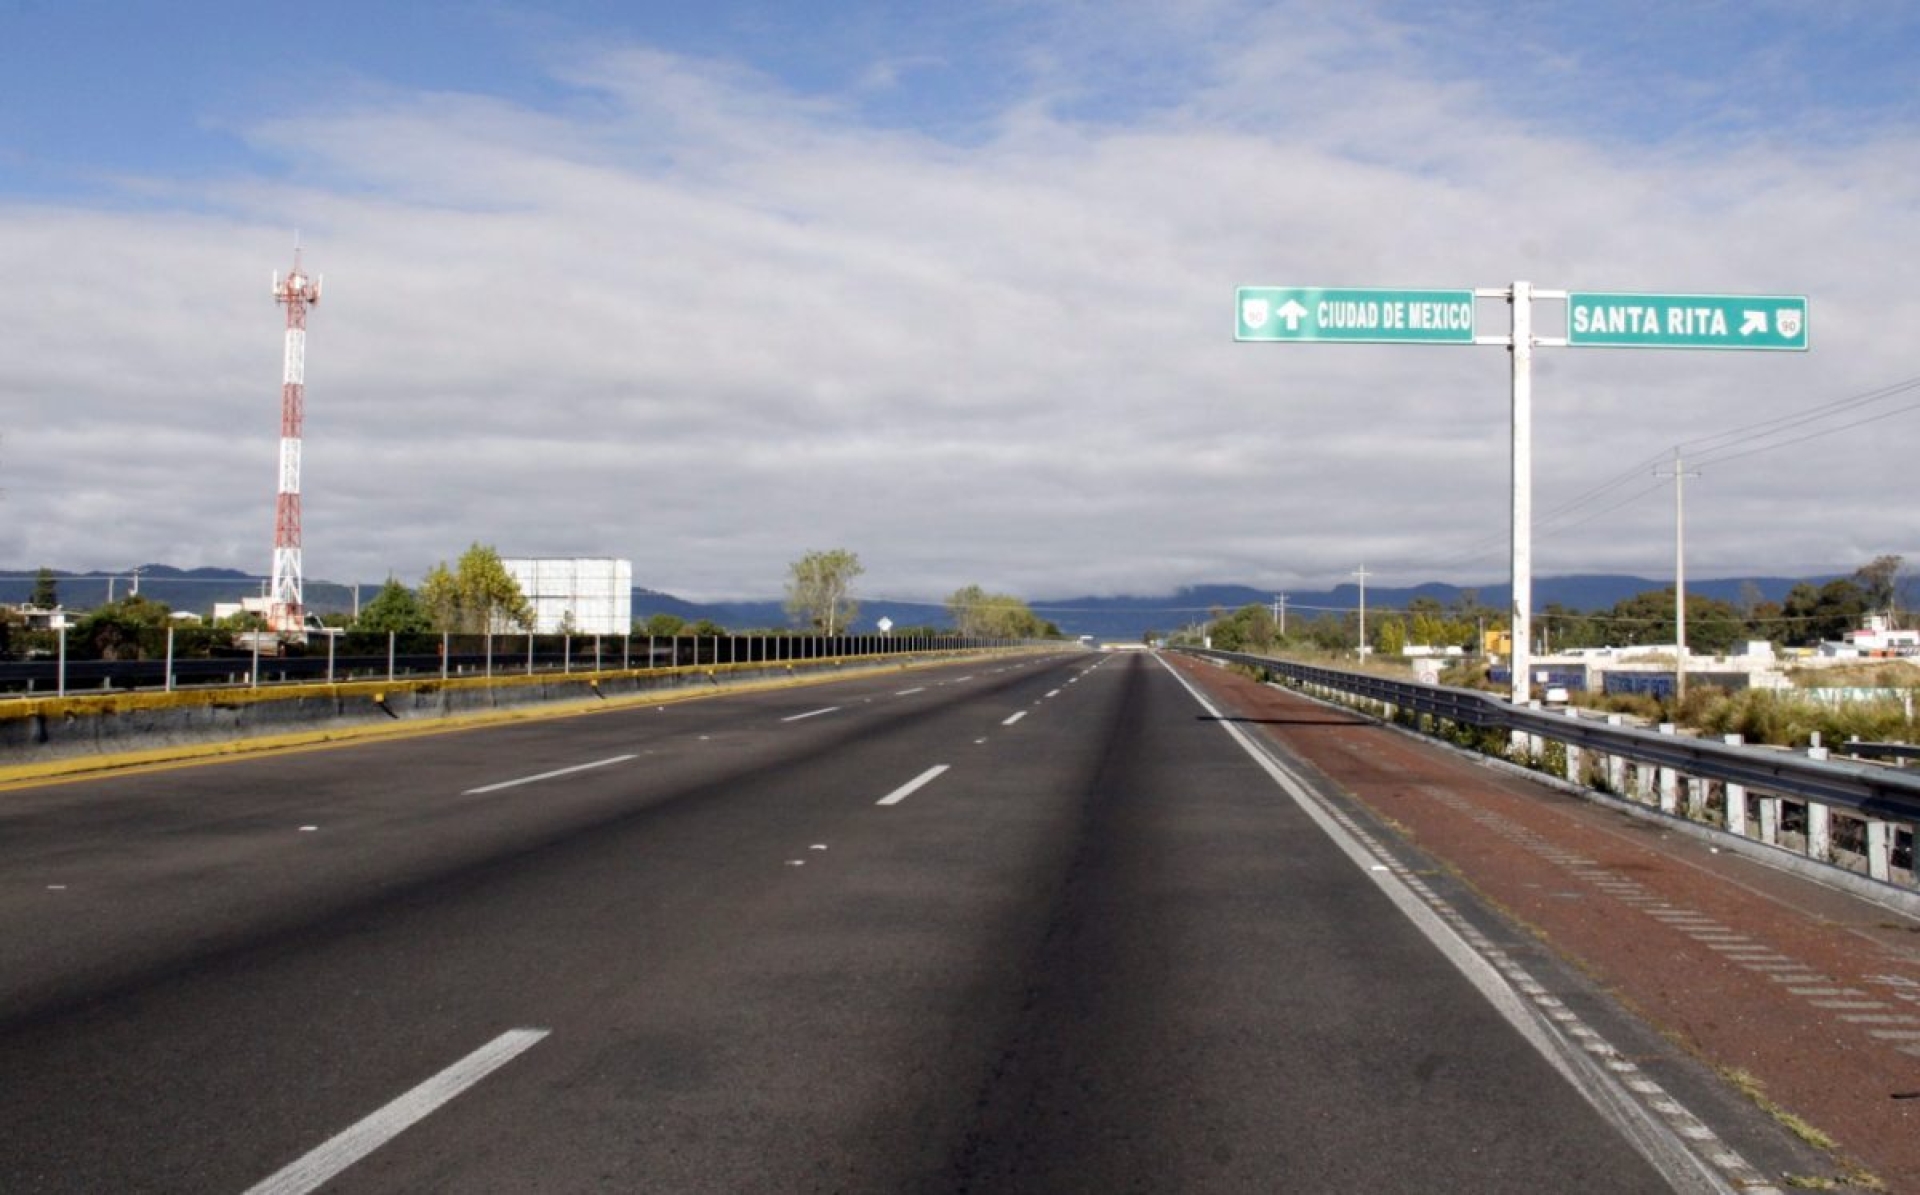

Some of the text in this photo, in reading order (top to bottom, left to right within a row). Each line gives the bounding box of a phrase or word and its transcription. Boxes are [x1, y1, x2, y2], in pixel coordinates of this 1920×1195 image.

[1317, 301, 1471, 331] CIUDAD DE MEXICO
[1573, 305, 1729, 336] SANTA RITA
[1781, 319, 1796, 332] 90
